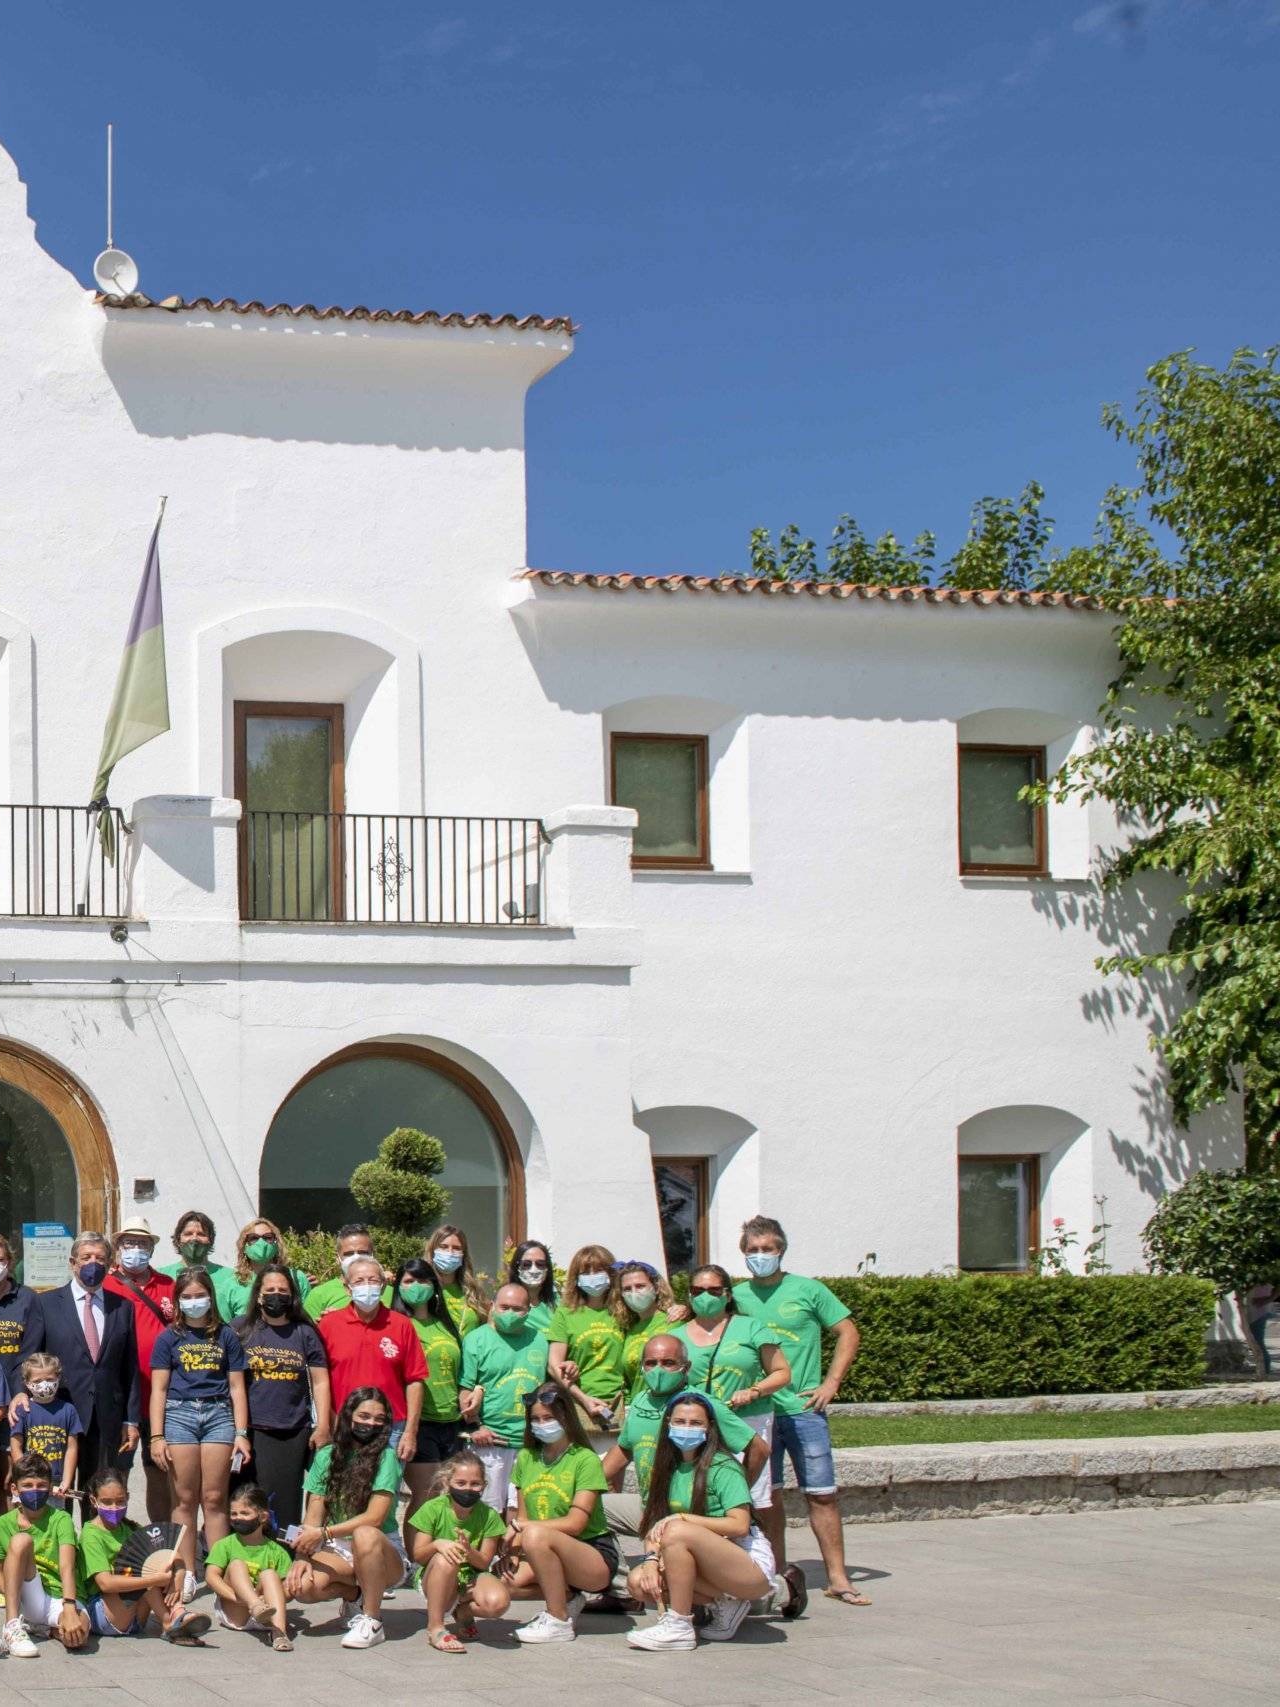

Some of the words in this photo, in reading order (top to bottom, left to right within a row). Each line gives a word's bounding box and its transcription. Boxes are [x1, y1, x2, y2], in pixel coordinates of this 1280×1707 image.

[246, 1345, 303, 1360] Villanueva
[191, 1361, 220, 1370] Cucos
[261, 1369, 299, 1380] Cucos
